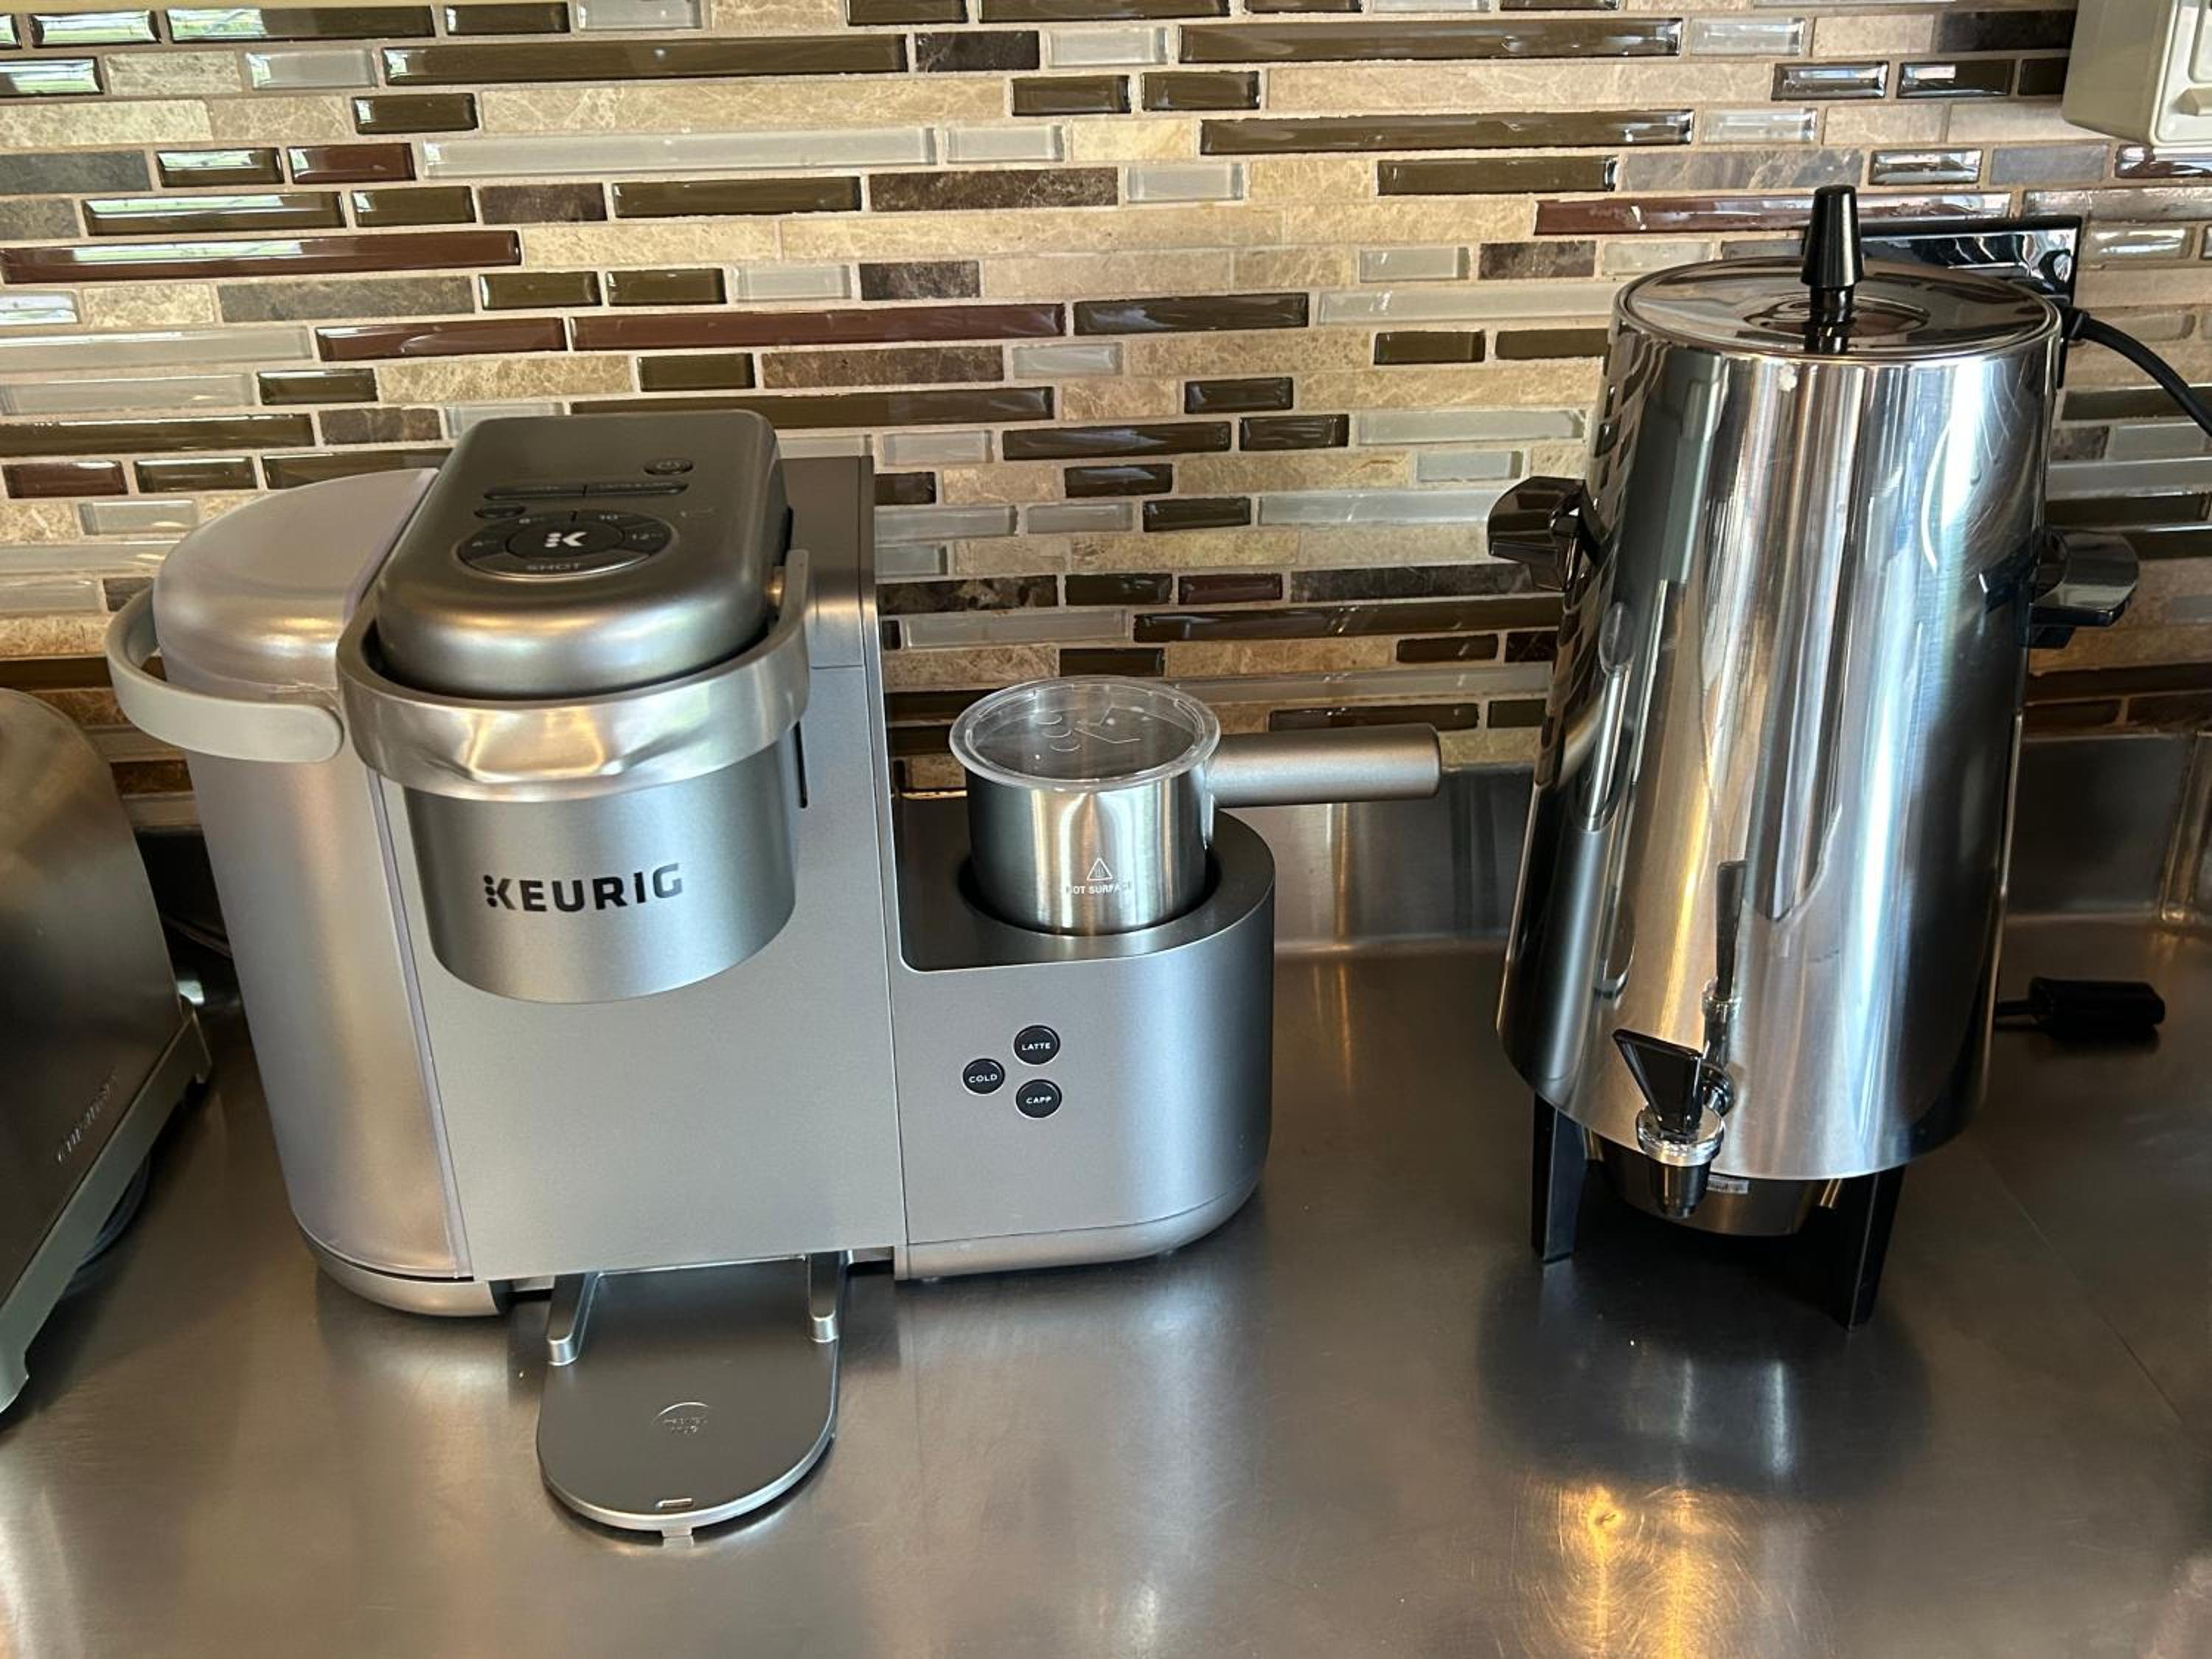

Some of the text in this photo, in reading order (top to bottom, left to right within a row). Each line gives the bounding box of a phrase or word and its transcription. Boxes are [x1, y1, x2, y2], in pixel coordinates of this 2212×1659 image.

[484, 863, 683, 912] KEURIG
[1021, 1042, 1051, 1051] LATTE
[968, 1074, 998, 1083] COLD
[1026, 1096, 1052, 1104] CAPP
